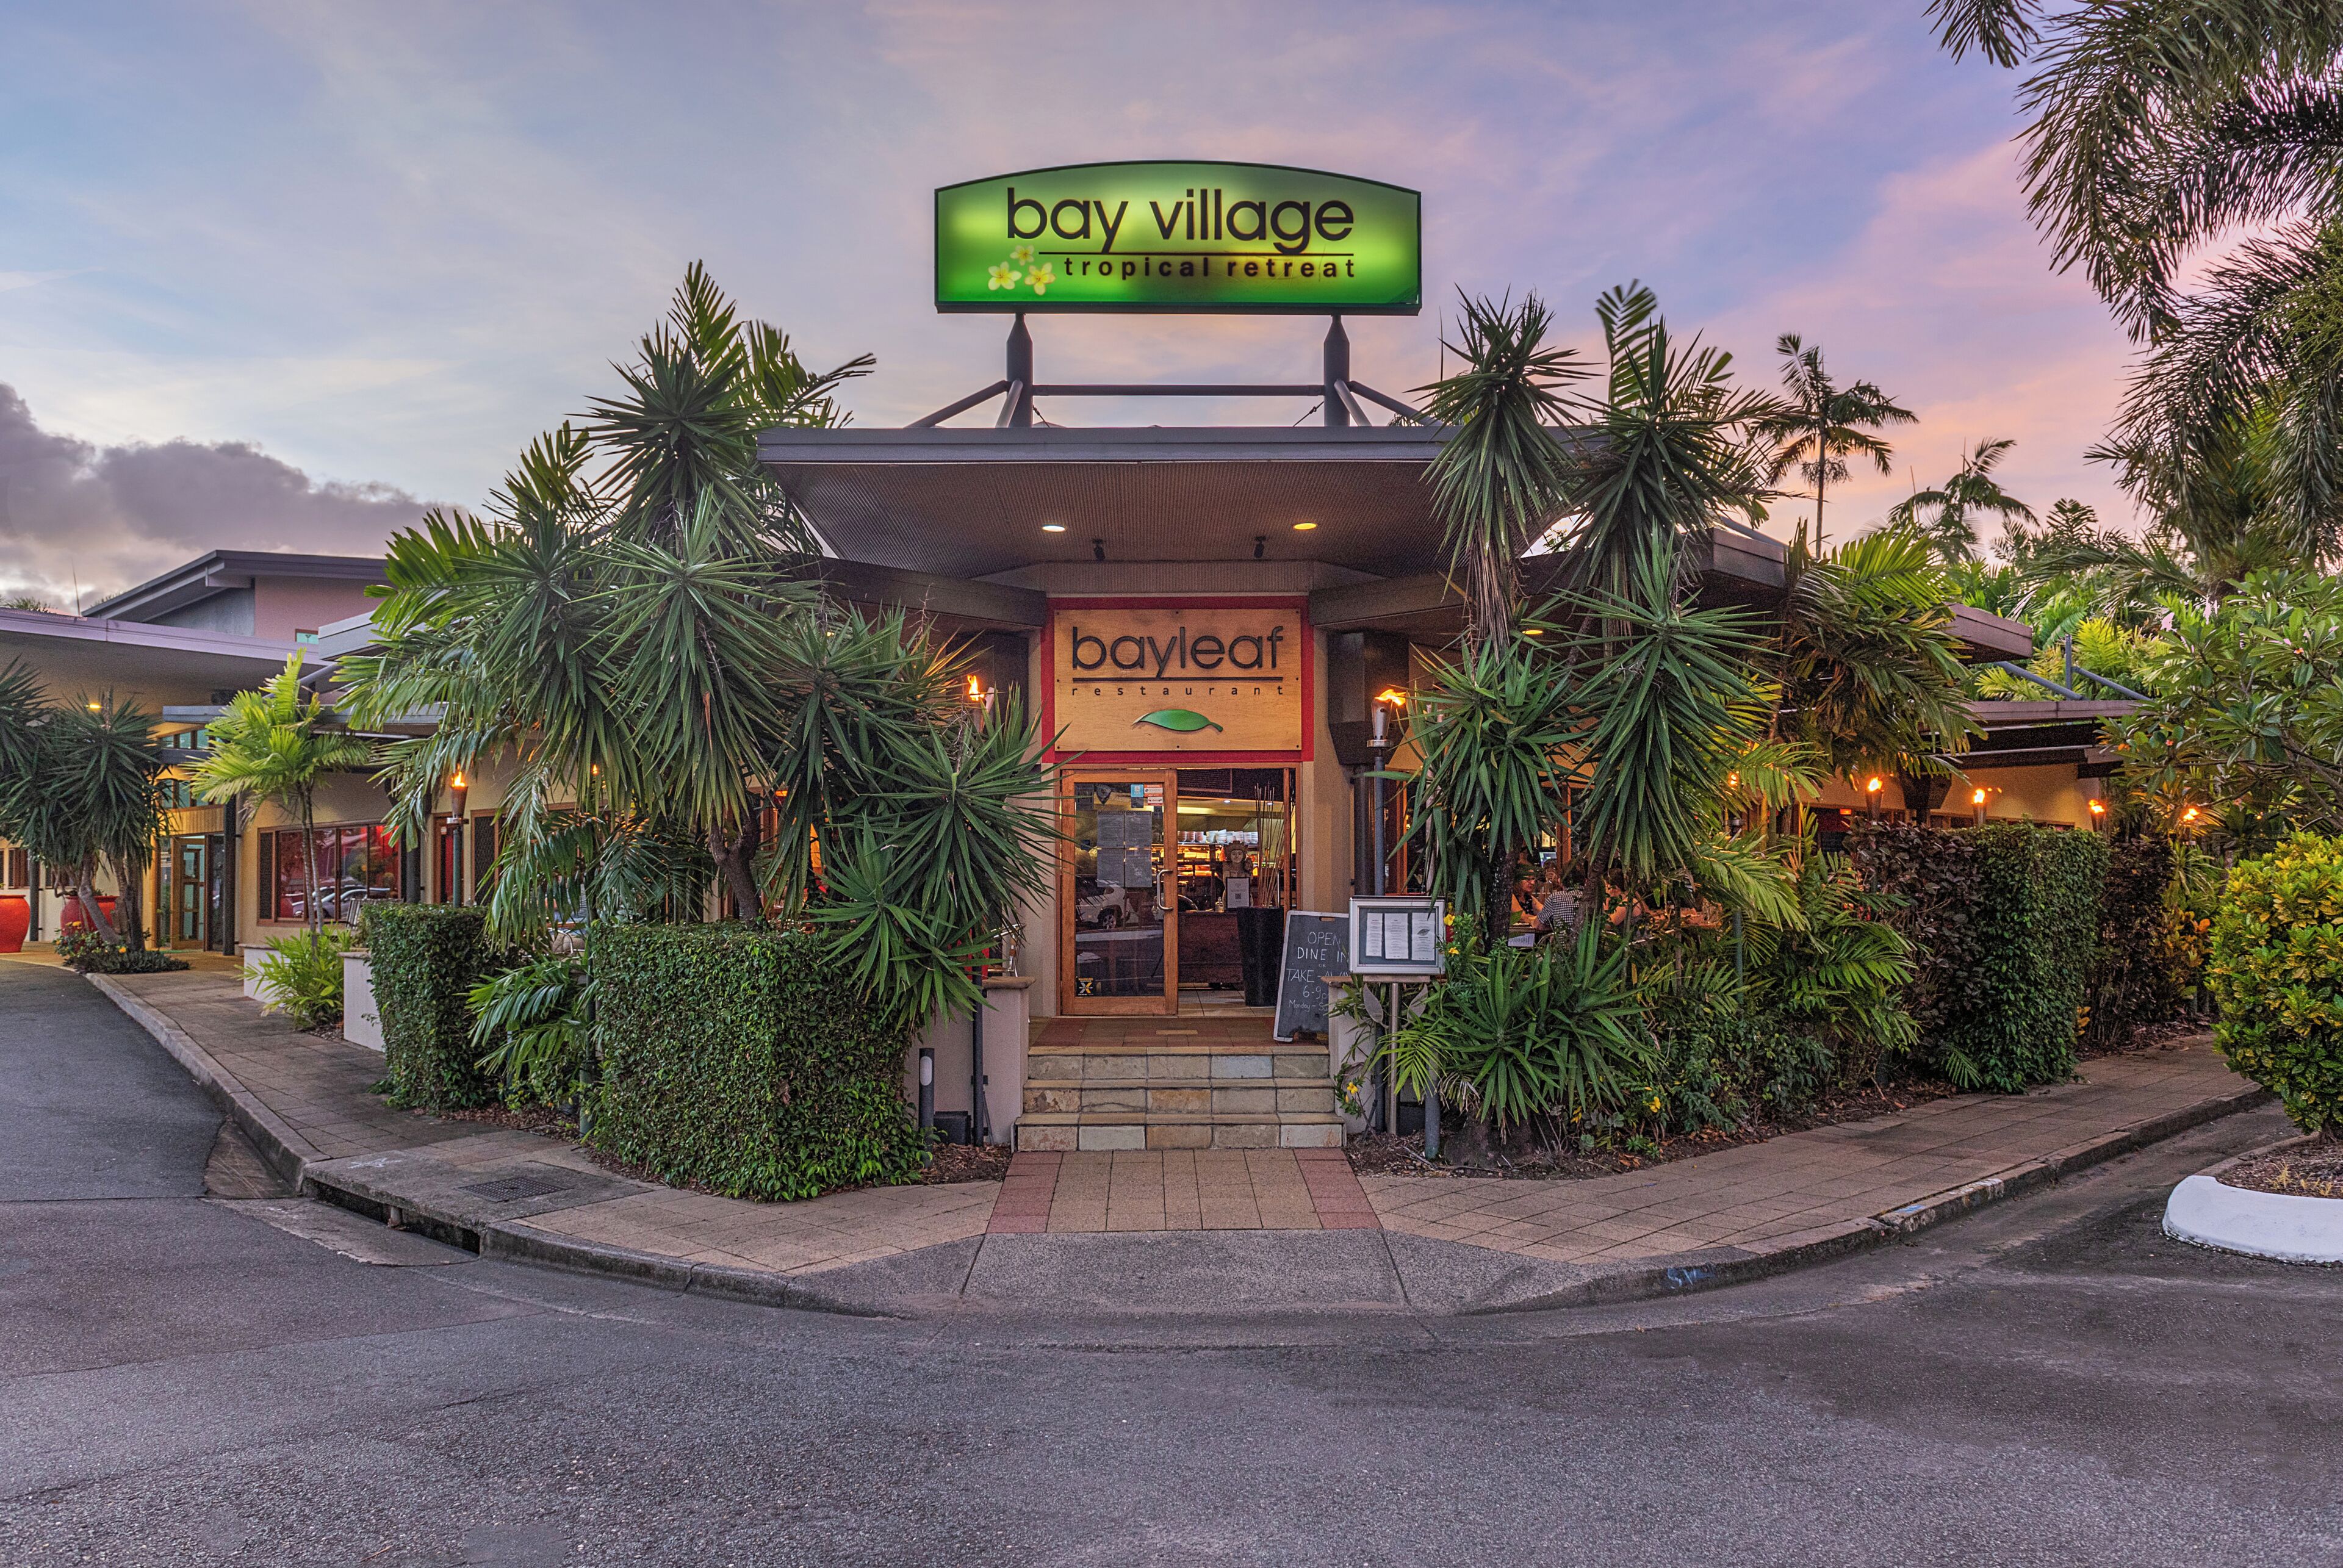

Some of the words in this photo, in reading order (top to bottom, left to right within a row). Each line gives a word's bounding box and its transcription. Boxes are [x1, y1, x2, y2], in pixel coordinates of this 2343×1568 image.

[1007, 187, 1129, 253] bay
[1149, 189, 1354, 253] village
[1064, 256, 1209, 281] tropical
[1227, 259, 1355, 278] retreat
[1072, 625, 1284, 678] bayleaf
[1072, 685, 1283, 696] restaurant
[1308, 932, 1341, 947] OPEN
[1297, 947, 1327, 960] DINE
